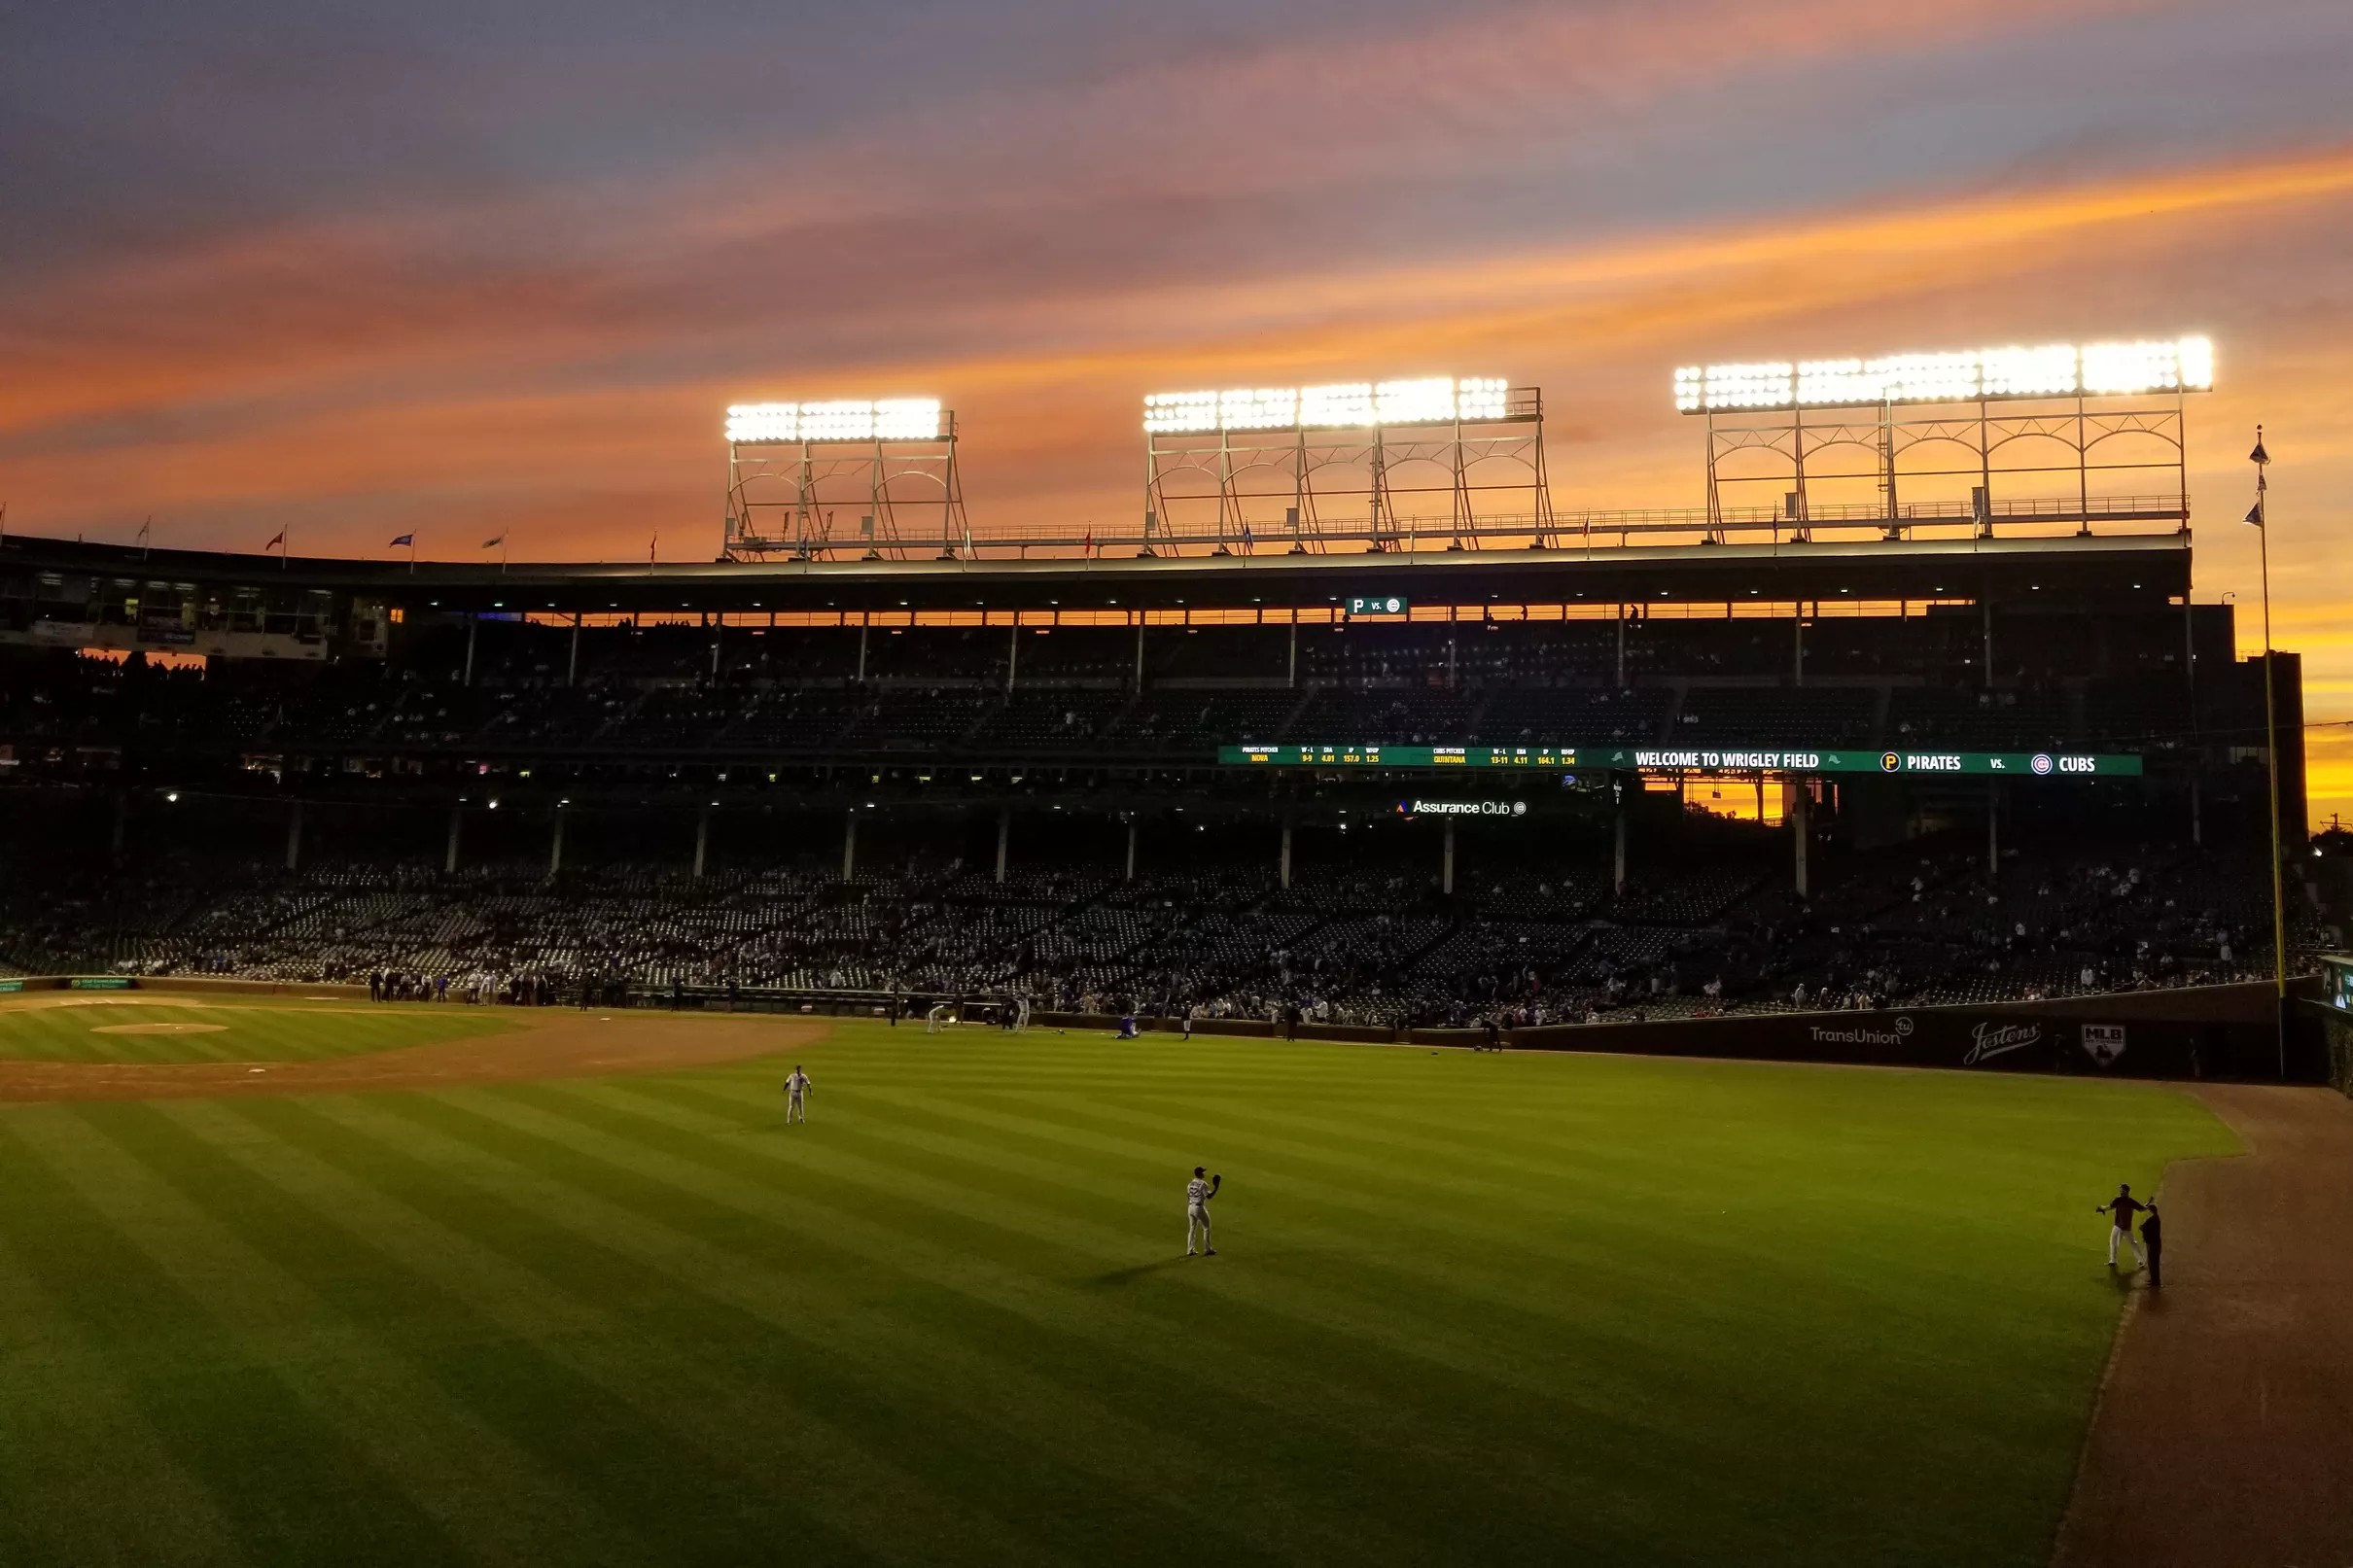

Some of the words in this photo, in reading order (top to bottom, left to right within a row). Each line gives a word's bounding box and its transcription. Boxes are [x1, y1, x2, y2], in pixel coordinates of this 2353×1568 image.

[1353, 599, 1363, 613] P
[1371, 602, 1382, 610] VS.
[1635, 751, 1699, 767] WELCOME
[1702, 752, 1719, 767] TO
[1722, 752, 1780, 768] WRIGLEY
[1783, 753, 1819, 768] FIELD
[1907, 755, 1961, 771] PIRATES
[1990, 758, 2005, 769] VS.
[2058, 757, 2095, 772] CUBS
[1413, 801, 1480, 814] Assurance
[1482, 802, 1510, 815] Club
[1810, 1027, 1901, 1045] TransUnion
[2085, 1028, 2123, 1040] MLB
[1963, 1022, 2041, 1065] Jostens
